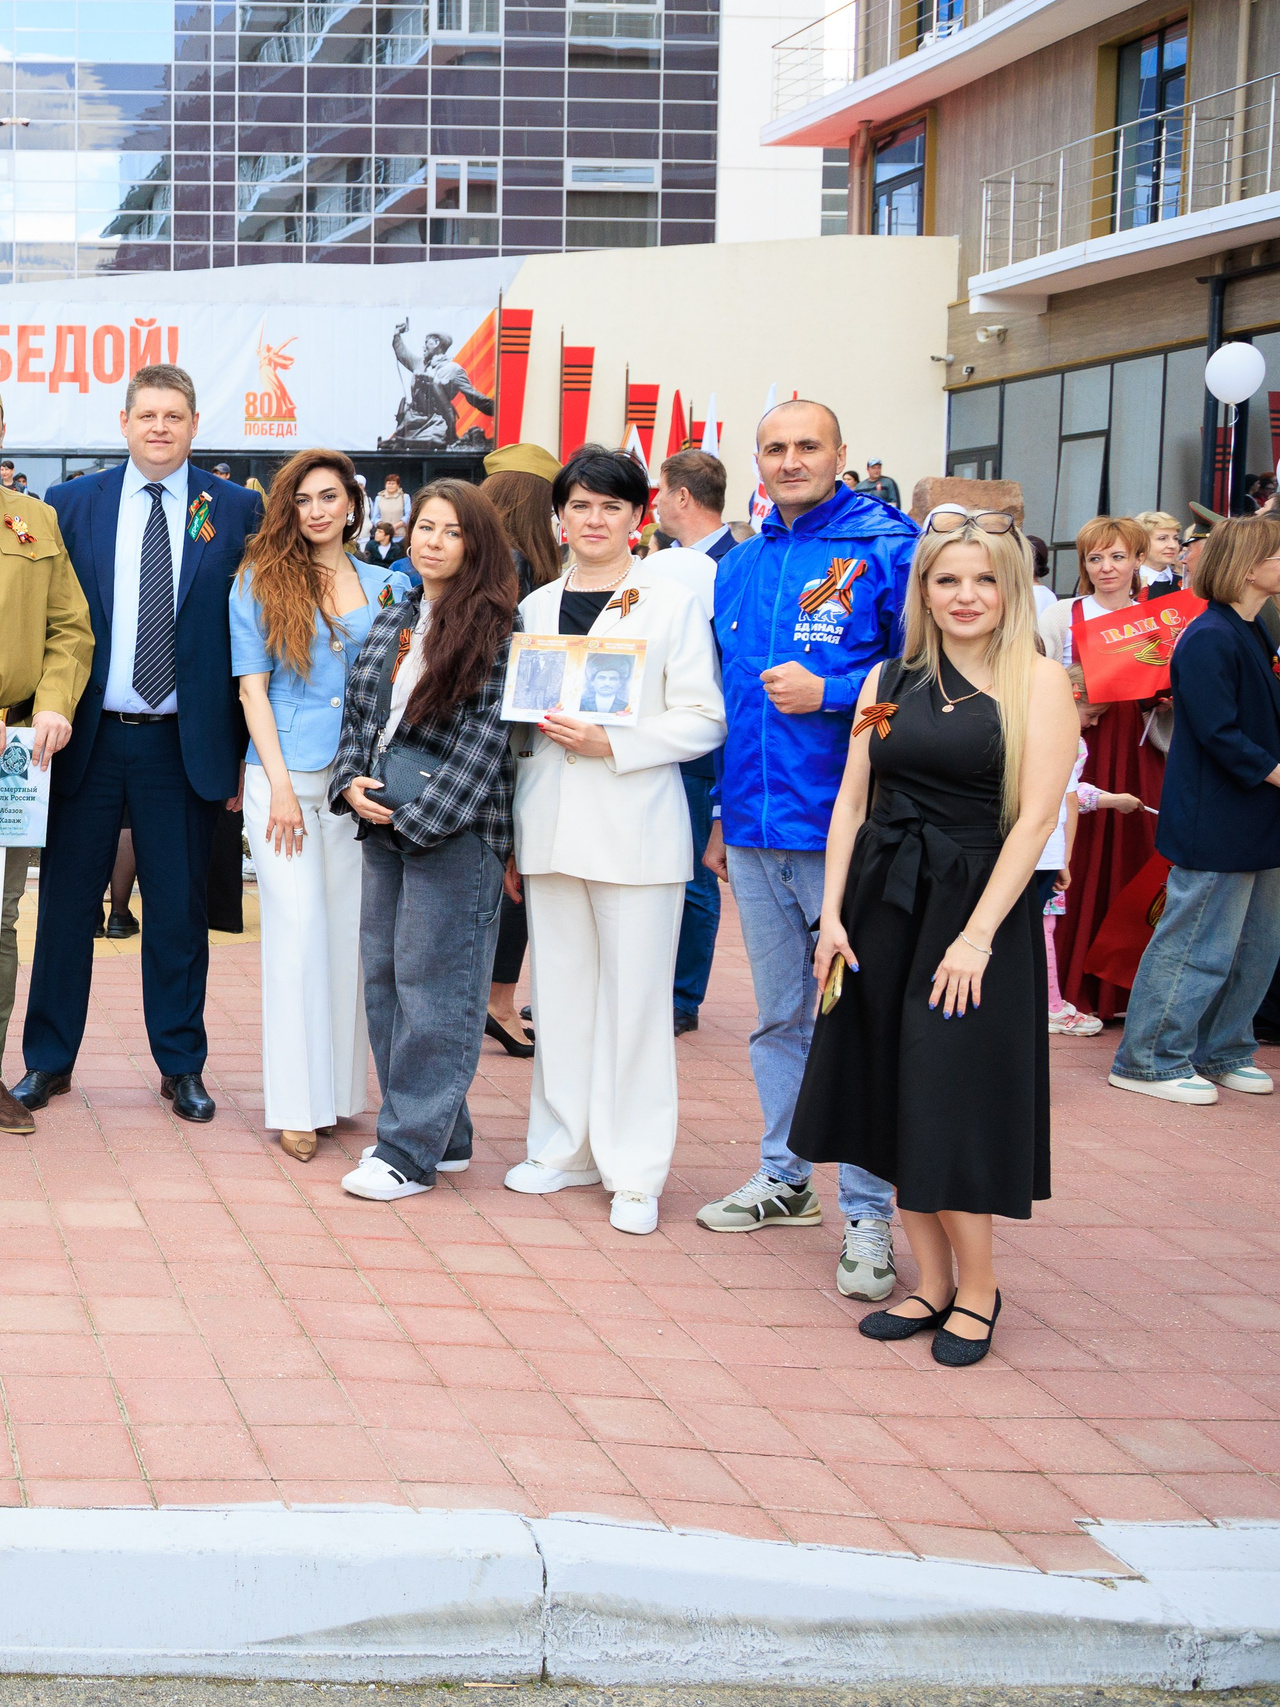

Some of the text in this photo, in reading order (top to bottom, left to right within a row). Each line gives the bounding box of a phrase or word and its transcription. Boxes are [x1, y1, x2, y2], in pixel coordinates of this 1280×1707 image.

[245, 391, 273, 417] 80
[244, 422, 297, 438] ПОБЕДА!
[794, 622, 844, 635] ЕДИНАЯ
[793, 632, 841, 645] РОССИЯ
